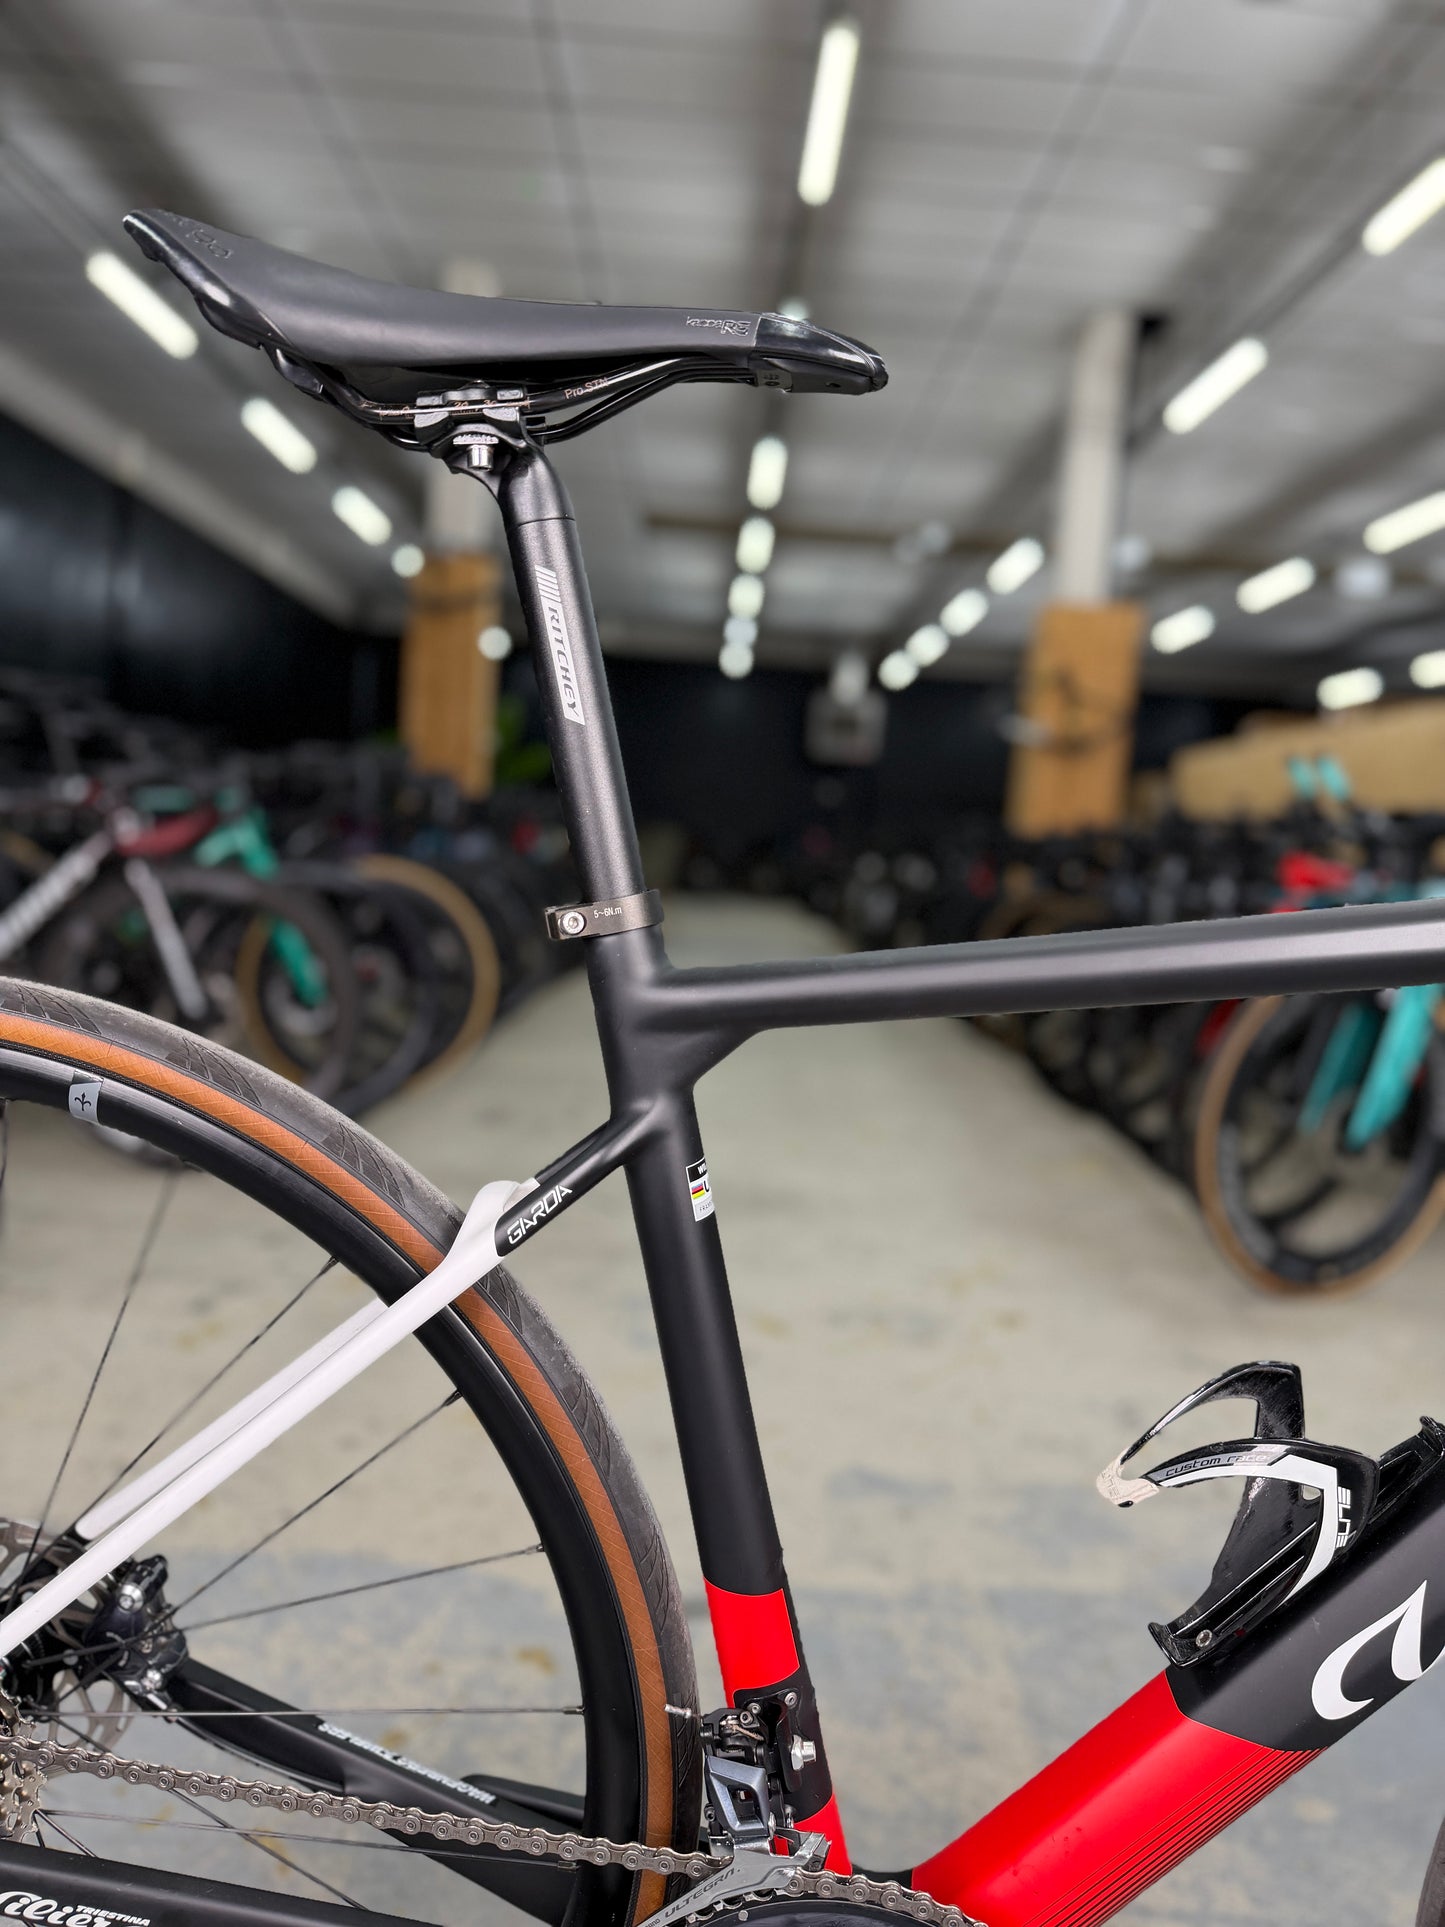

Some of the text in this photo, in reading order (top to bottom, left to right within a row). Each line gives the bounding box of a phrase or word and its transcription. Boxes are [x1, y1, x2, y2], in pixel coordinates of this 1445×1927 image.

[548, 605, 580, 717] RITCHEY
[507, 1185, 573, 1244] GARDA
[1166, 1457, 1221, 1476] custom
[76, 1905, 150, 1926] TRIESTINA
[665, 1868, 734, 1917] ULTEGRA
